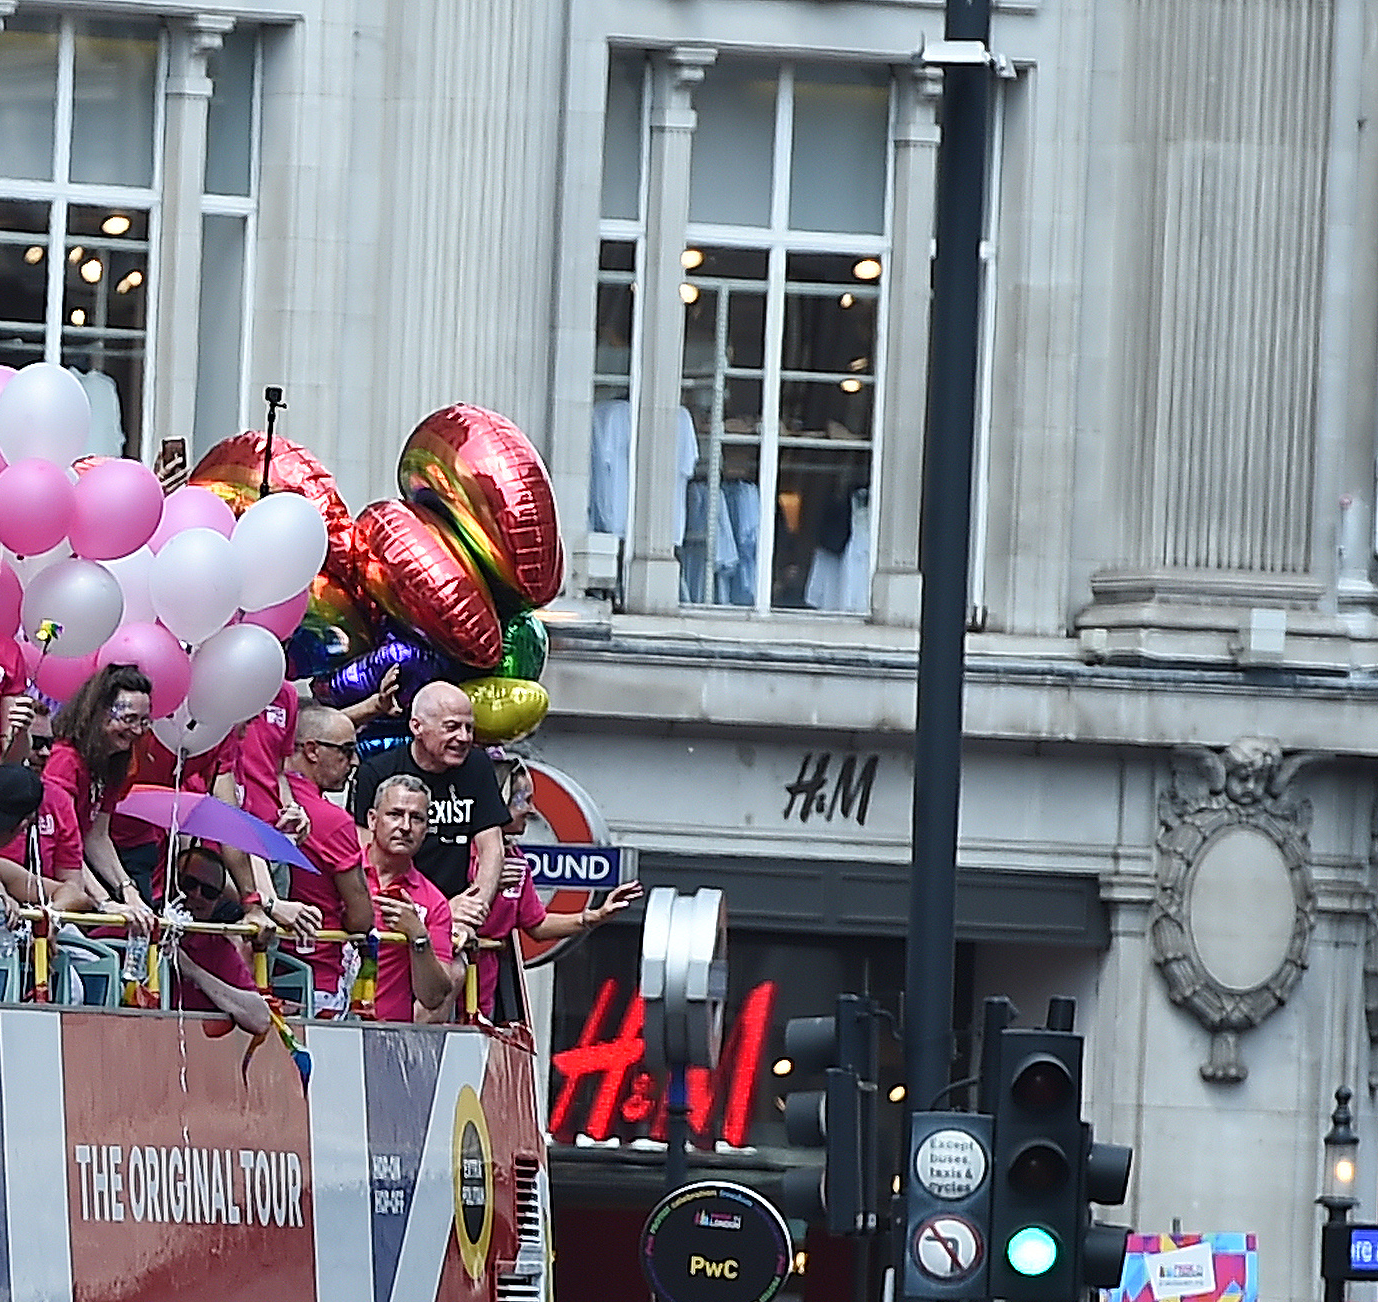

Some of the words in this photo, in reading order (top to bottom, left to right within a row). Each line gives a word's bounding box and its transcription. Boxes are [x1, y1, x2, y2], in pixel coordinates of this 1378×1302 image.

[783, 752, 879, 826] H&M
[930, 1138, 974, 1151] Except
[75, 1144, 125, 1222] THE
[129, 1145, 240, 1225] ORIGINAL
[239, 1149, 304, 1228] TOUR
[690, 1255, 739, 1280] PwC
